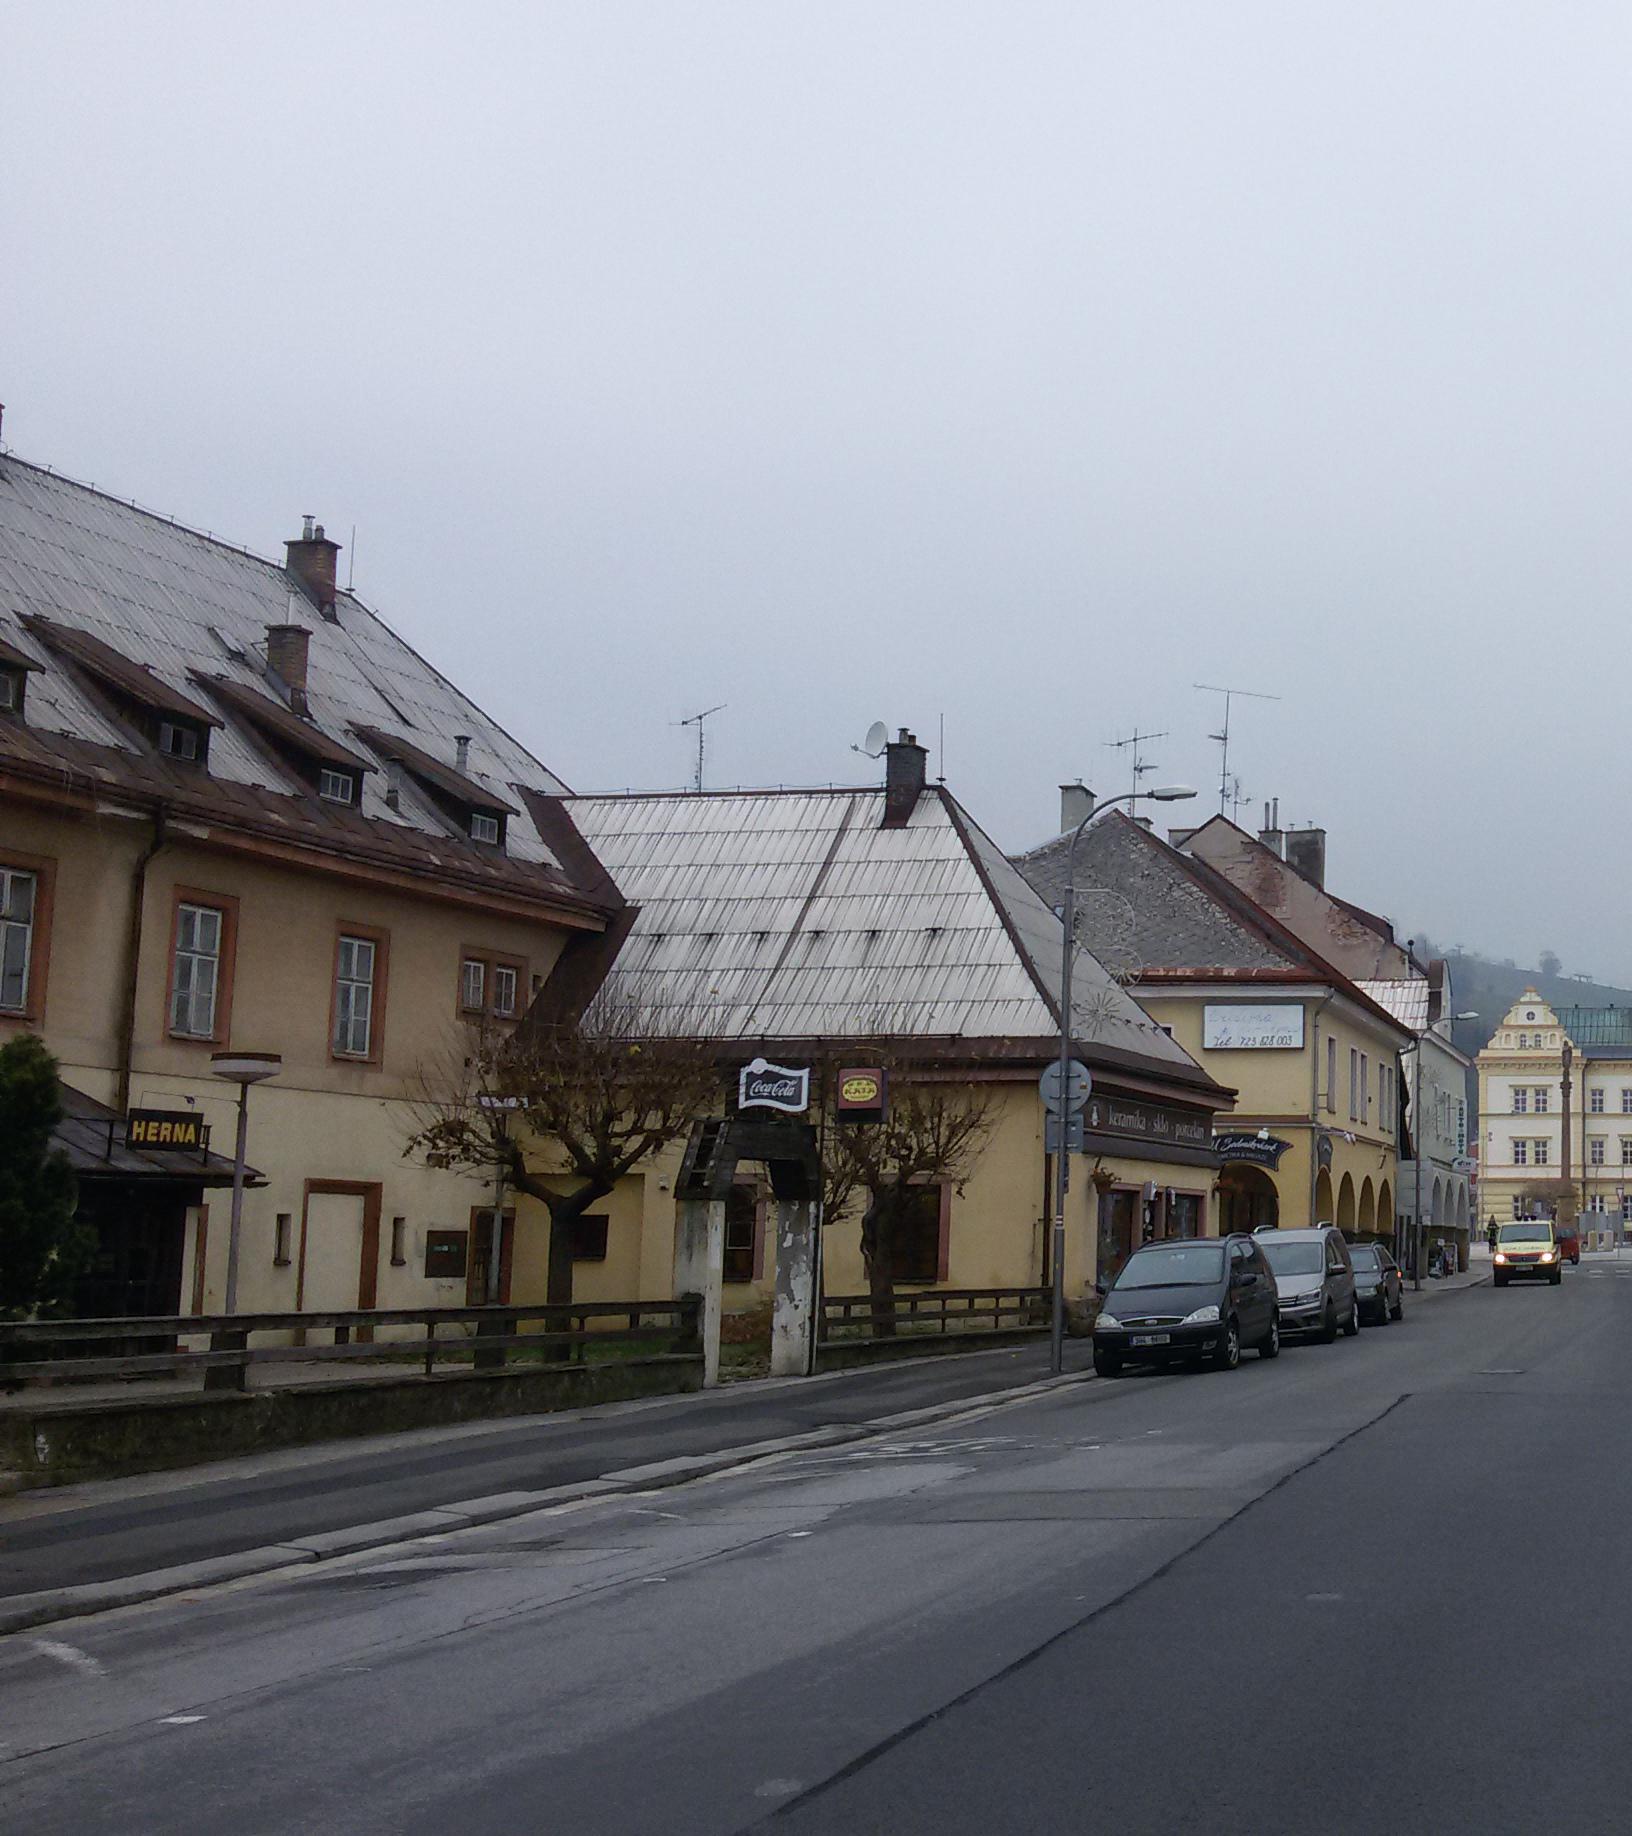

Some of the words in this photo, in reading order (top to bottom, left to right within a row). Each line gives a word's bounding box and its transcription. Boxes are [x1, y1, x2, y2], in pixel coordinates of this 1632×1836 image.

[749, 1079, 799, 1098] Coca-Cola
[1109, 1104, 1147, 1132] keramika
[1152, 1112, 1169, 1135] sklo
[132, 1120, 196, 1144] HERNA
